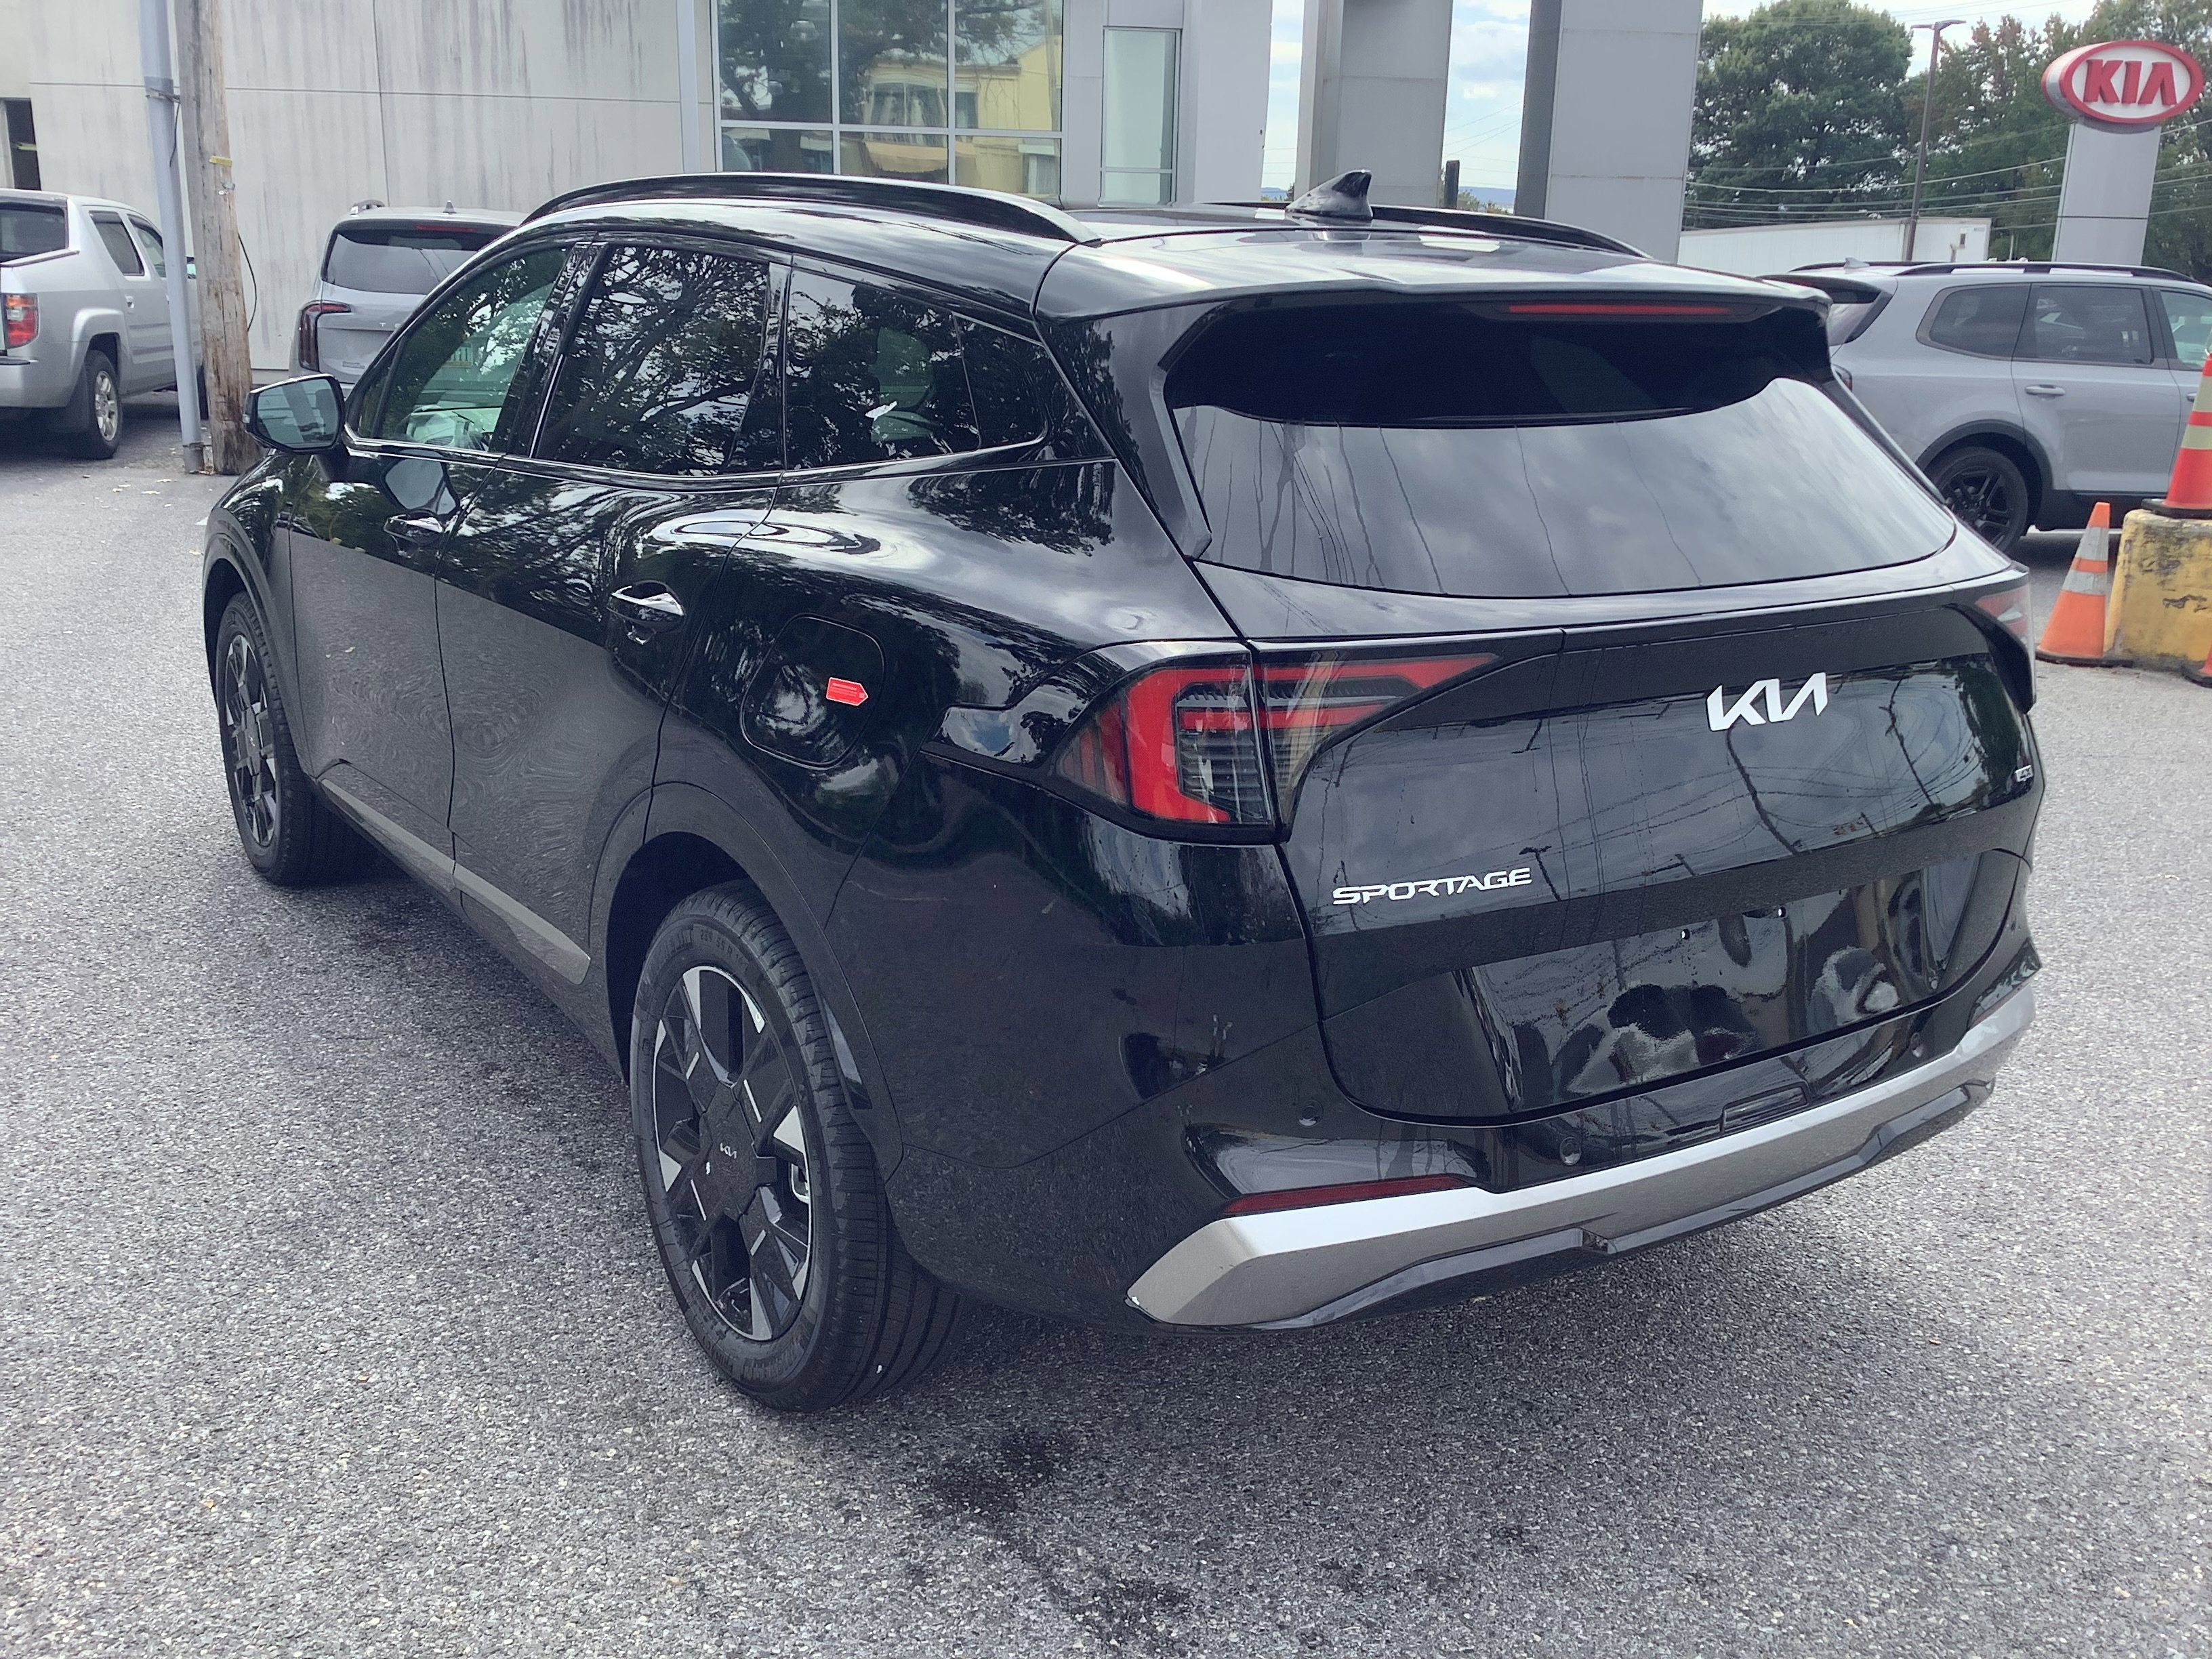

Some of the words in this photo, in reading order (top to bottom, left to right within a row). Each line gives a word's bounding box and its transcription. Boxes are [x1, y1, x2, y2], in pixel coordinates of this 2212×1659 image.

[2083, 59, 2177, 106] KIA
[1706, 672, 1828, 732] KIA
[1332, 867, 1533, 905] SPORTAGE
